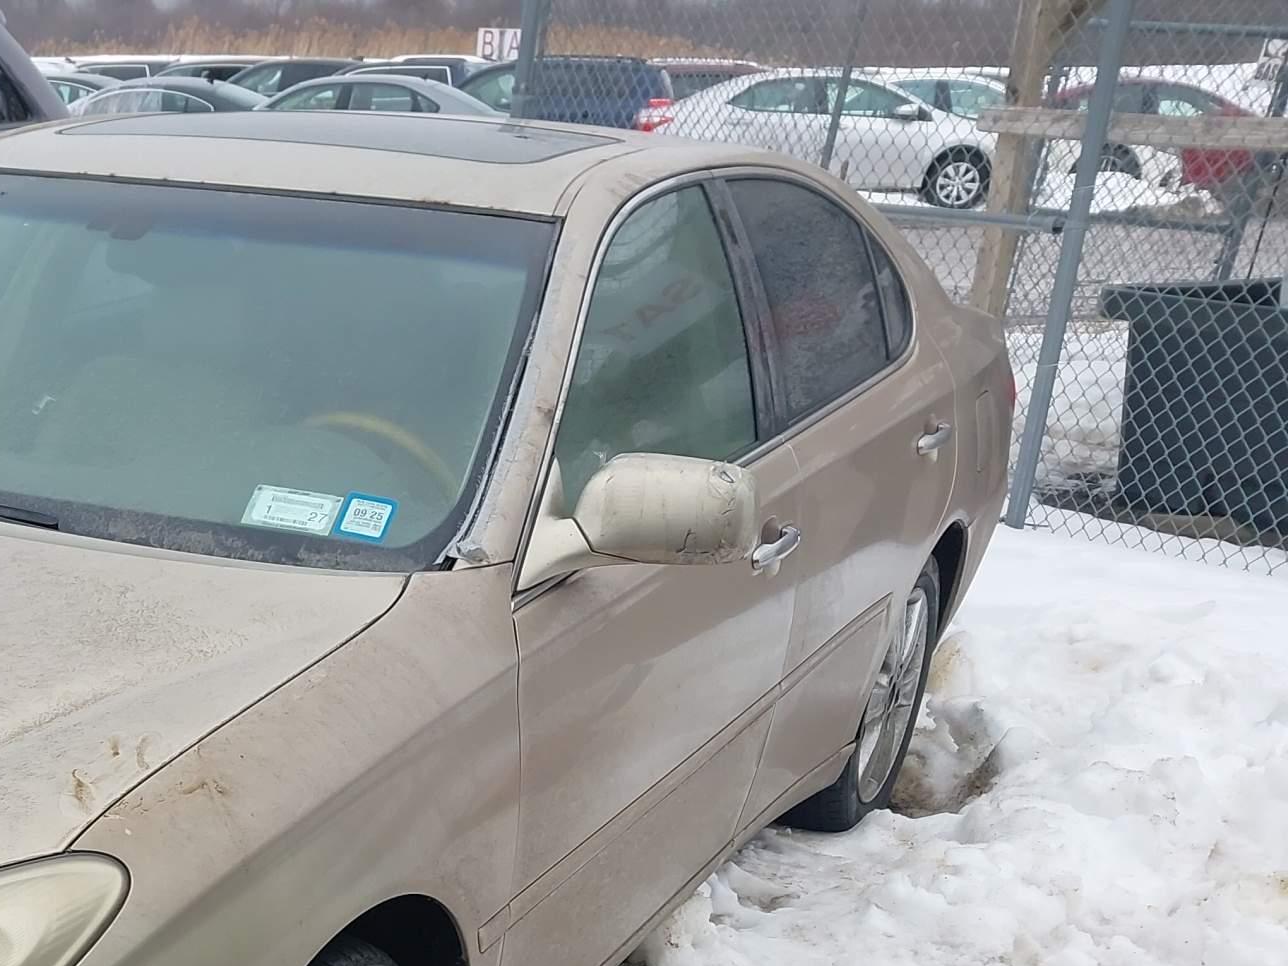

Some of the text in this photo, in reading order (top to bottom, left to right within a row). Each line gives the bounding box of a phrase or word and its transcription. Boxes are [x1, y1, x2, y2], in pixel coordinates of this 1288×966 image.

[482, 30, 494, 58] B
[506, 31, 520, 58] A
[307, 511, 329, 524] 27
[353, 507, 385, 521] 09 25
